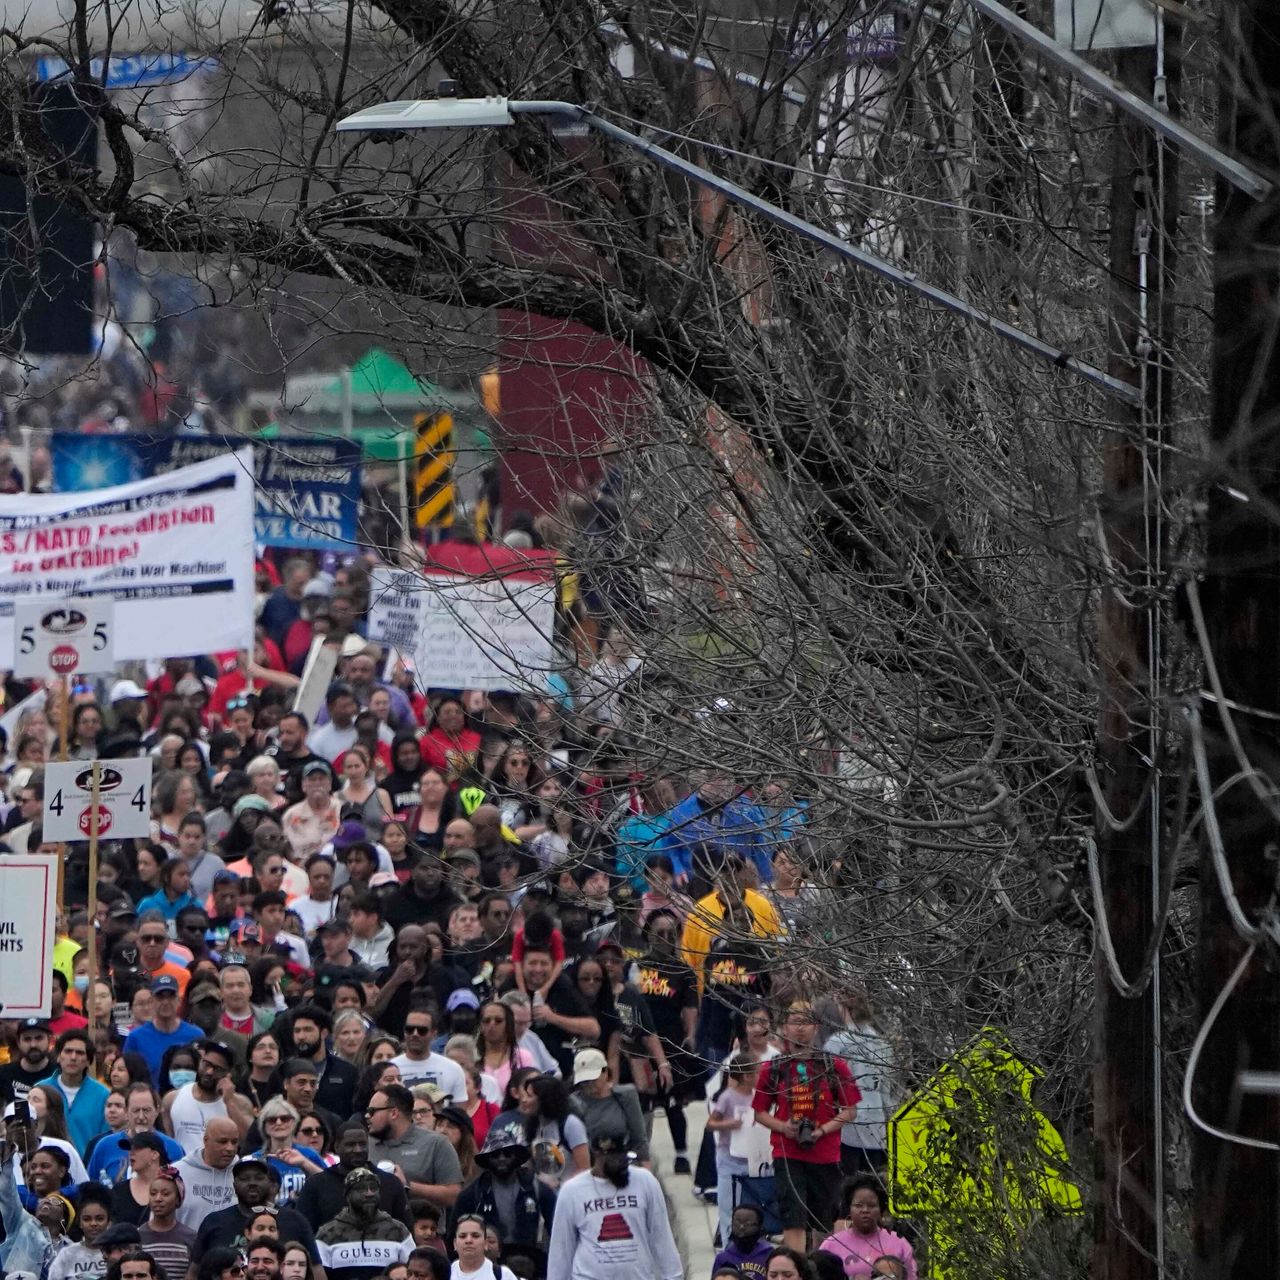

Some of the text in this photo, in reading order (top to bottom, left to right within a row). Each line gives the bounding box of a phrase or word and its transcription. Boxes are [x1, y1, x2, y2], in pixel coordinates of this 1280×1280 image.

[293, 519, 341, 541] GOD
[140, 565, 164, 577] War
[20, 623, 107, 653] 5 5
[51, 653, 77, 665] STOP
[49, 789, 64, 816] 4
[131, 784, 146, 812] 4
[583, 1195, 638, 1213] KRESS
[340, 1248, 390, 1259] GUESS
